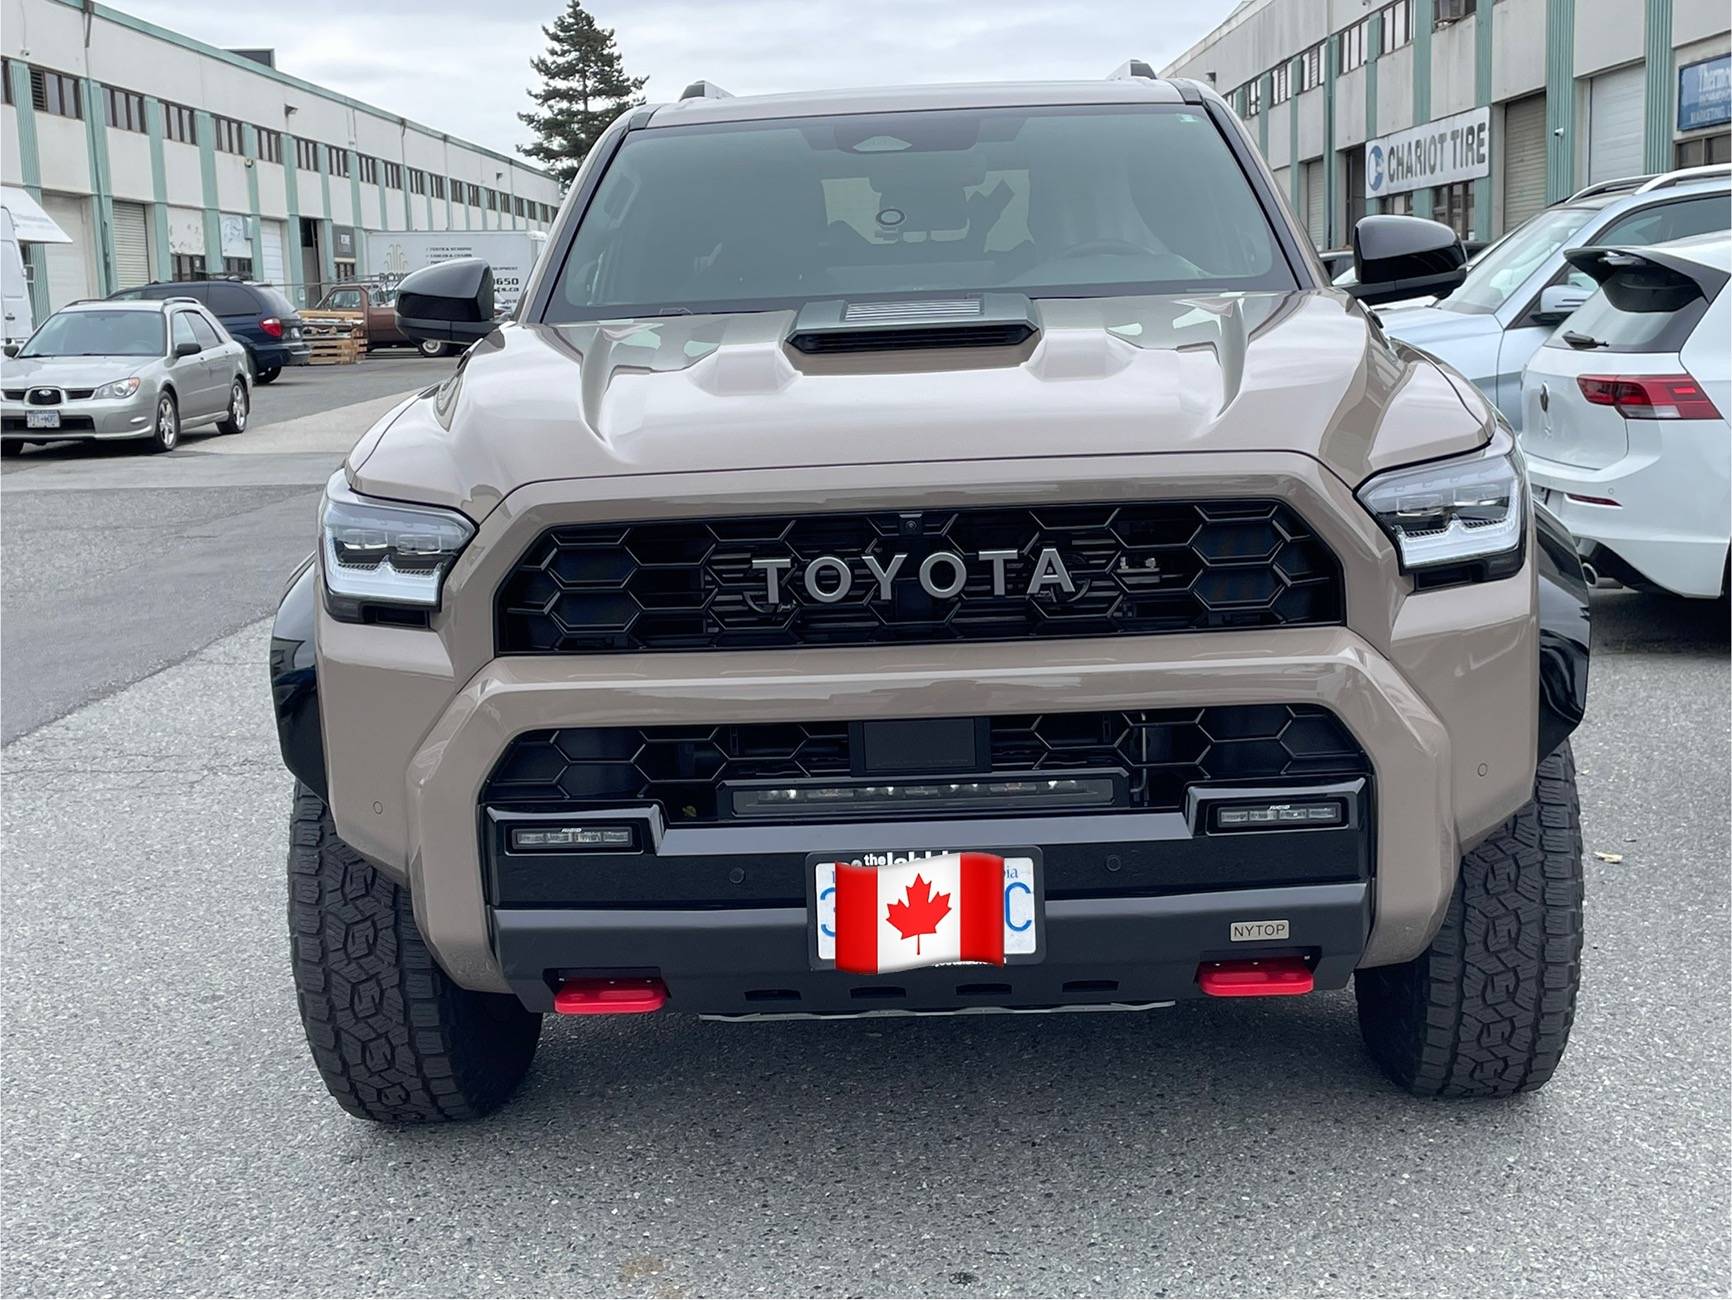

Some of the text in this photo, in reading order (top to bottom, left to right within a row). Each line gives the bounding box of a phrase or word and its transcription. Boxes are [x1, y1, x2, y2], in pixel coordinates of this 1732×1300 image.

[1388, 122, 1486, 183] CHARIOT TIRE
[751, 547, 1076, 604] TOYOTA
[864, 853, 886, 866] the
[1233, 924, 1286, 937] NYTOP
